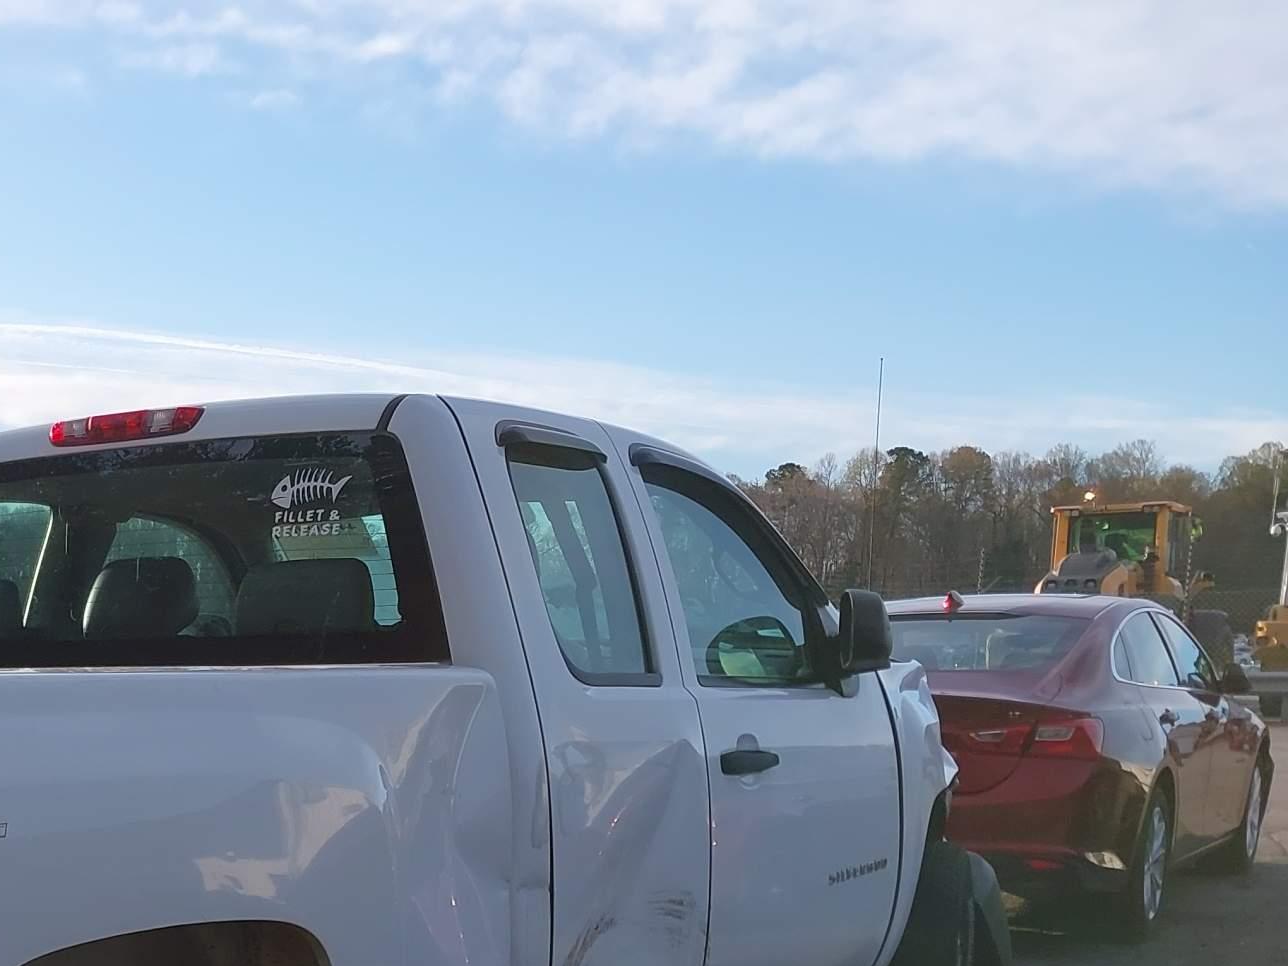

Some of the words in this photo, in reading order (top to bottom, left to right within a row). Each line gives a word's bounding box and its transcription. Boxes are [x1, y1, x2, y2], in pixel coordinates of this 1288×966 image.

[274, 509, 325, 523] FILLET
[329, 509, 340, 521] &
[272, 523, 341, 538] RELEASE
